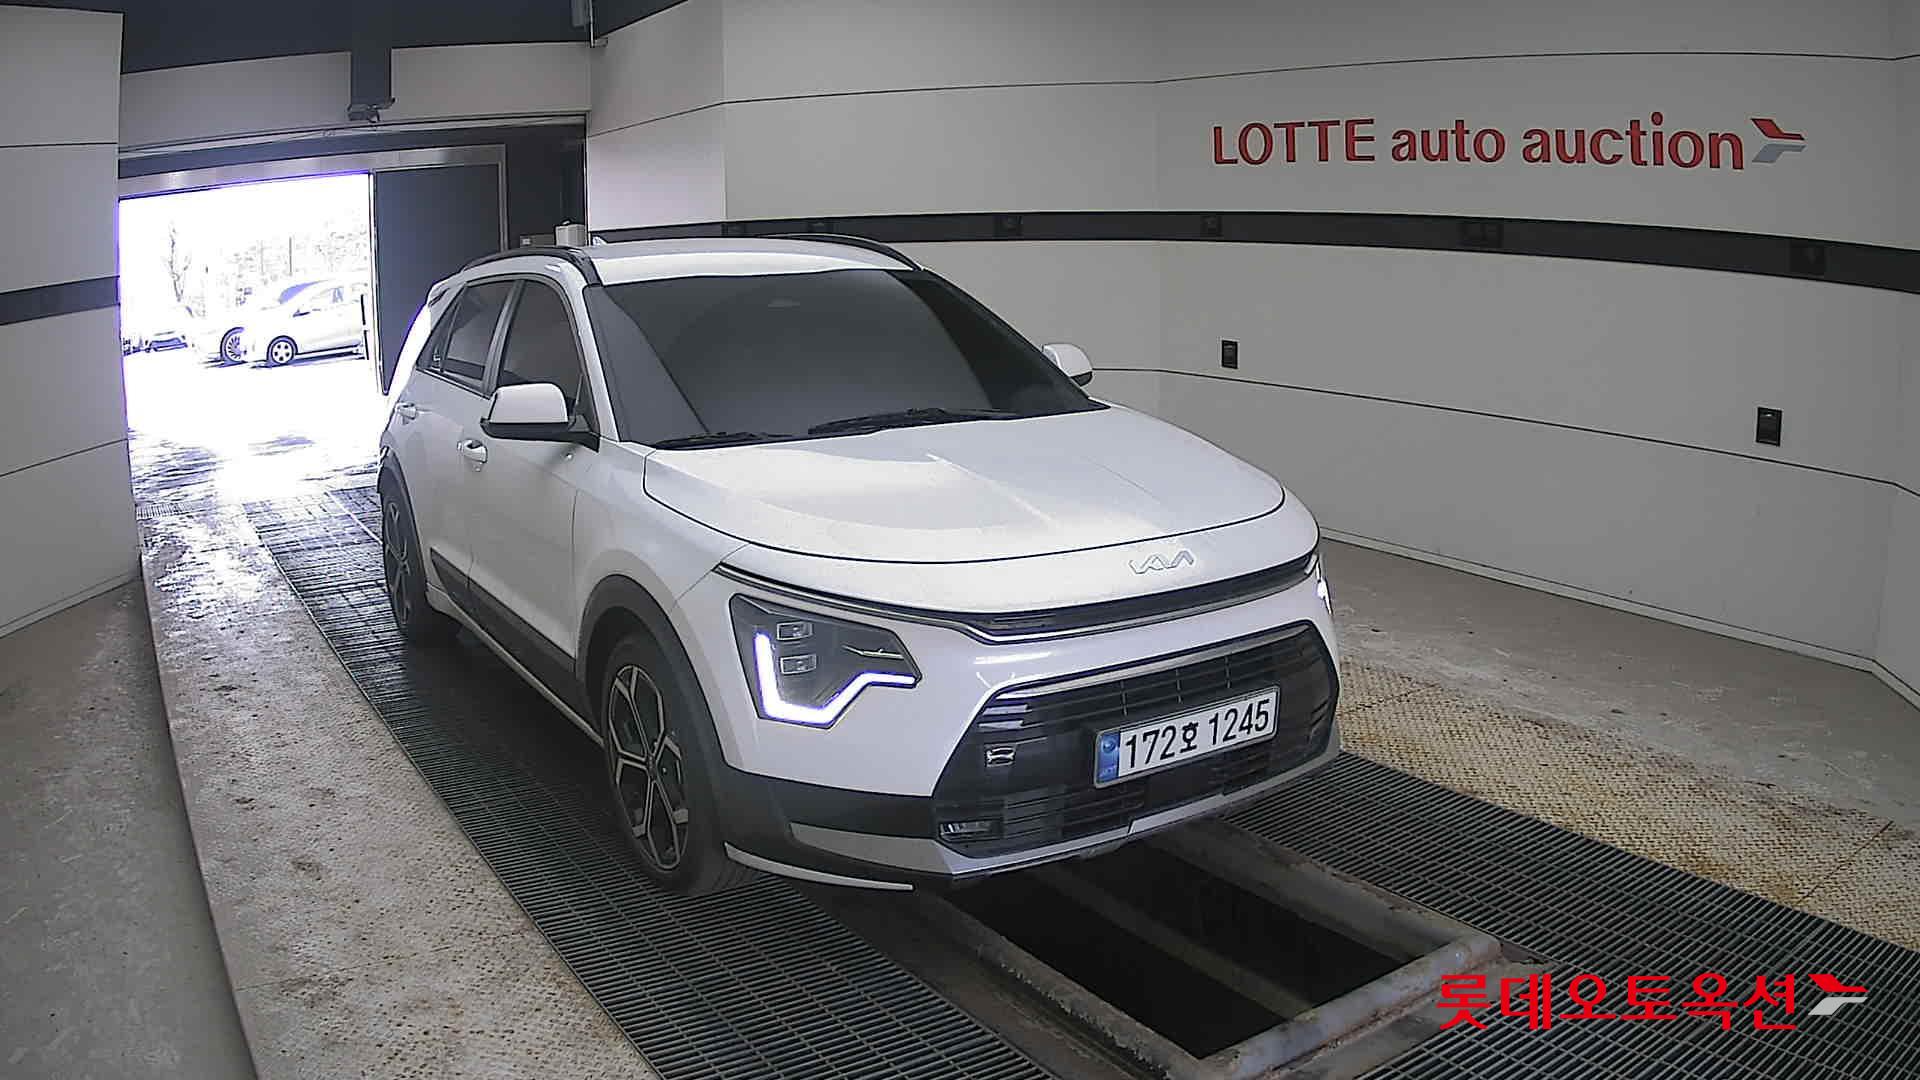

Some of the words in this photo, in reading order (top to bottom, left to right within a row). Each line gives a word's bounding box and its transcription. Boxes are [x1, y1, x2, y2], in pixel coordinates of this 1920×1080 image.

[1212, 117, 1376, 166] LOTTE
[1391, 119, 1506, 164] auto
[1522, 111, 1745, 170] auction
[1125, 721, 1200, 769] 172호
[1208, 698, 1271, 746] 1245
